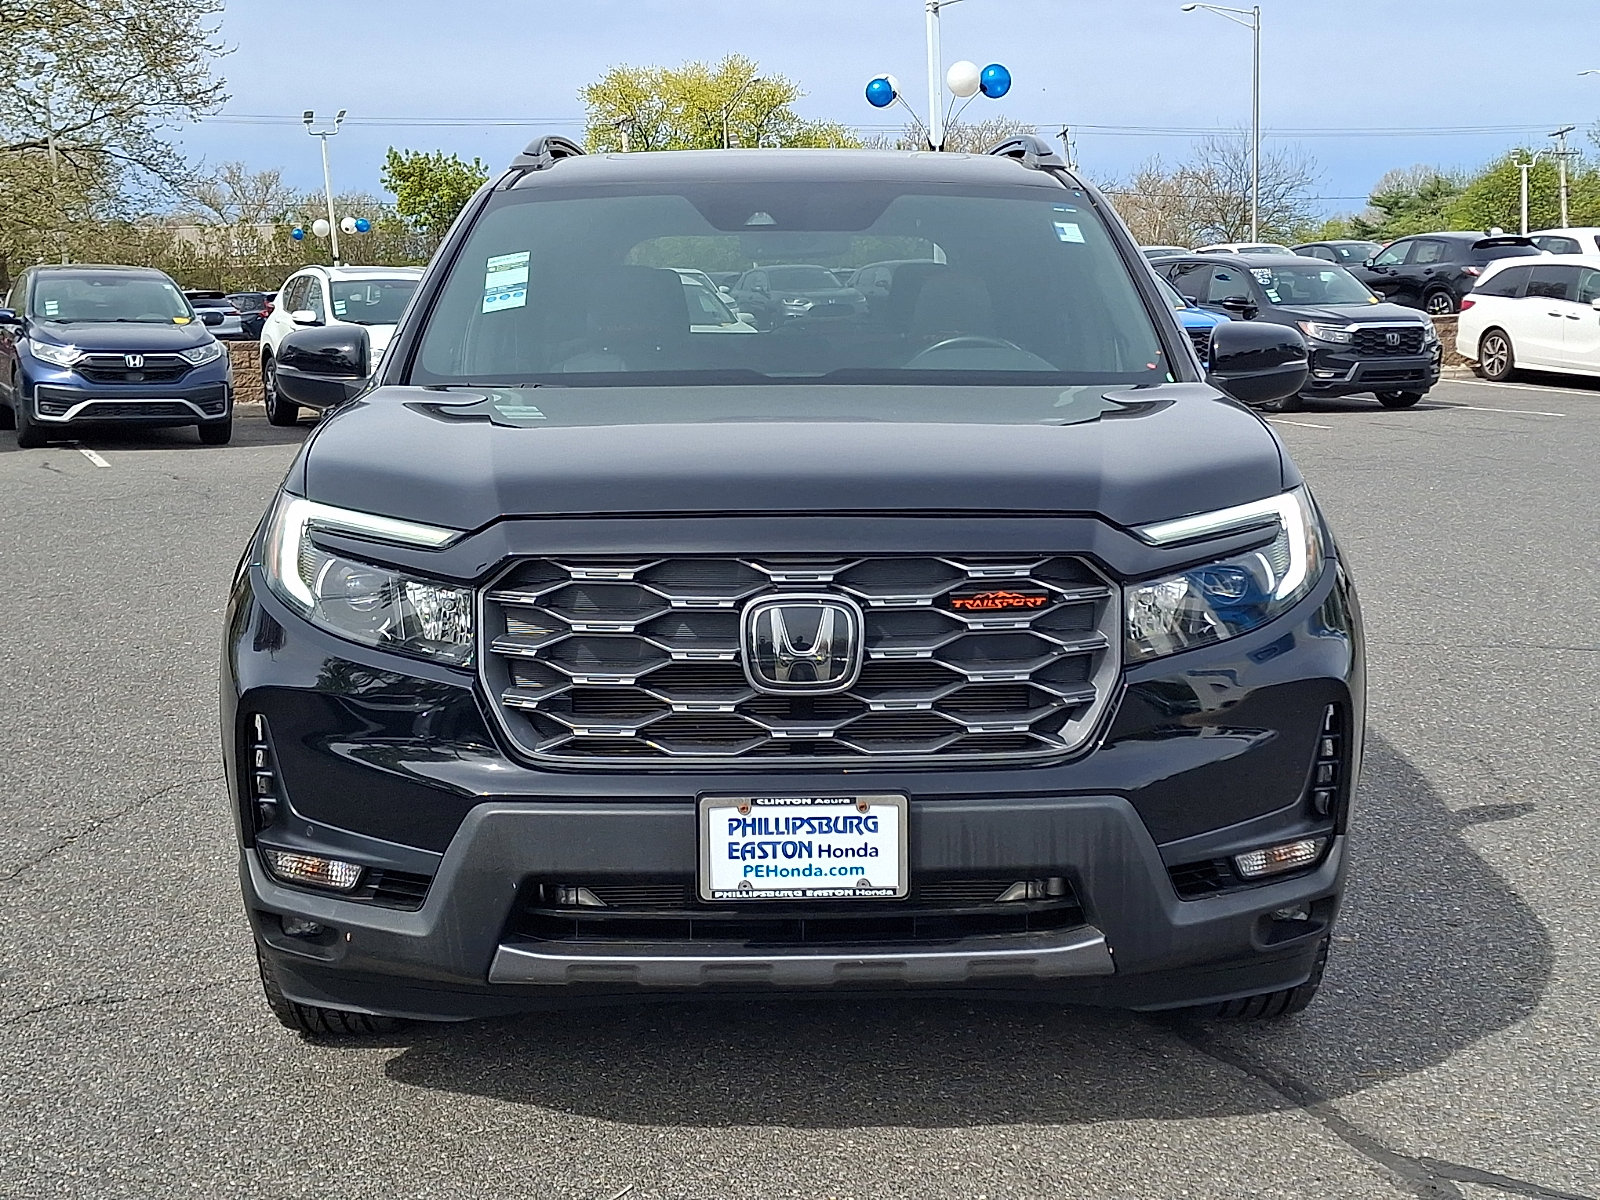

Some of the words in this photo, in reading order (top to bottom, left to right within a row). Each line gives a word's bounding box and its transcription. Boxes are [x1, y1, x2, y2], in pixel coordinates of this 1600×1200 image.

[952, 597, 1047, 610] TRAILSPORT
[727, 815, 879, 838] PHILLIPSBURG
[728, 840, 813, 861] EASTON
[818, 842, 879, 859] Honda
[743, 863, 865, 878] PEHonda.com
[806, 889, 854, 897] EASTON
